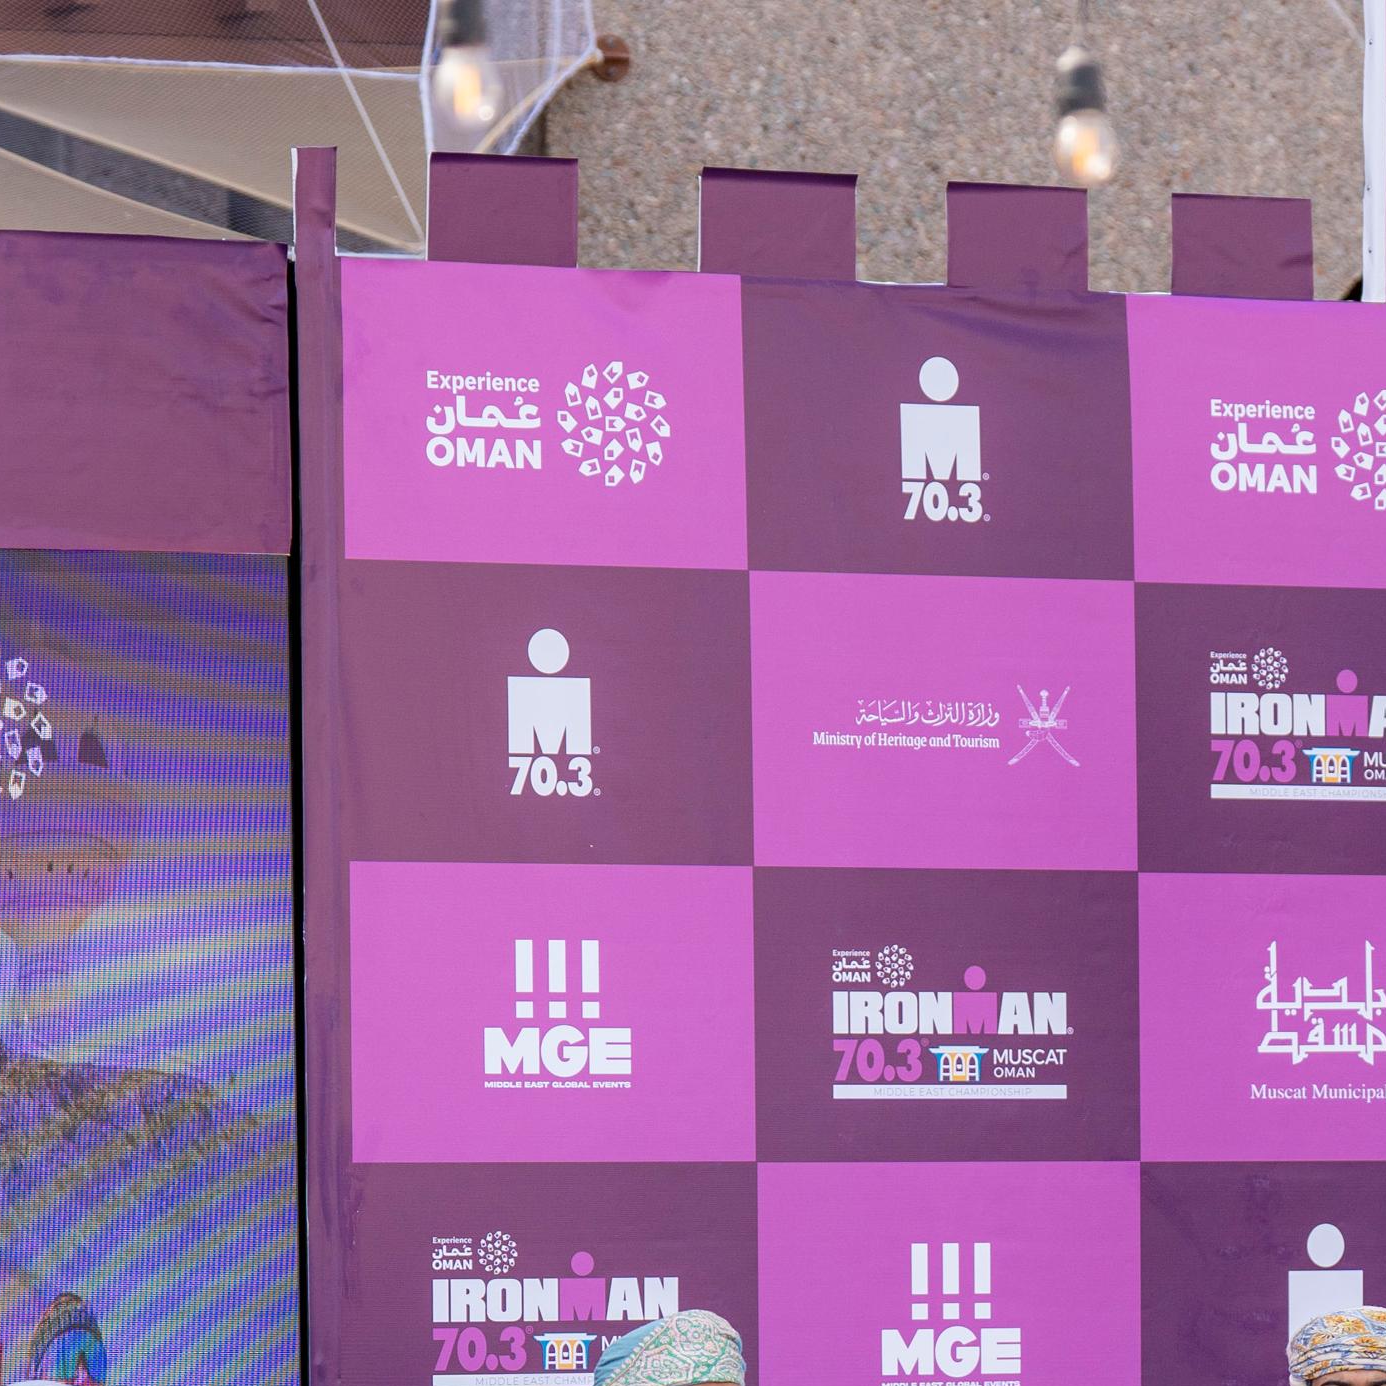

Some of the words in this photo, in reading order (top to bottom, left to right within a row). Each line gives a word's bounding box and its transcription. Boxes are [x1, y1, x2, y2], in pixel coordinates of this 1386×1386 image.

[426, 371, 540, 394] Experience
[1211, 399, 1315, 421] Experience
[426, 436, 541, 469] OMAN
[1211, 462, 1317, 493] OMAN
[1210, 672, 1247, 684] OMAN
[813, 731, 861, 748] Ministry
[864, 731, 876, 746] of
[878, 732, 926, 749] Heritage
[929, 733, 951, 748] and
[953, 734, 1000, 748] Tourism
[832, 949, 870, 957] Experience
[832, 972, 871, 982] OMAN
[484, 1025, 631, 1078] MGE
[993, 1049, 1066, 1065] MUSCAT
[994, 1067, 1035, 1078] OMAN
[874, 1088, 915, 1097] MIDDLE
[919, 1088, 944, 1097] EAST
[948, 1087, 1031, 1096] CHAMPIONSHIP
[1251, 1084, 1307, 1100] Muscat
[432, 1237, 472, 1245] Experience
[432, 1260, 472, 1270] OMAN
[881, 1326, 1021, 1378] MGE
[475, 1376, 520, 1386] MIDDLE
[523, 1376, 550, 1386] EAST
